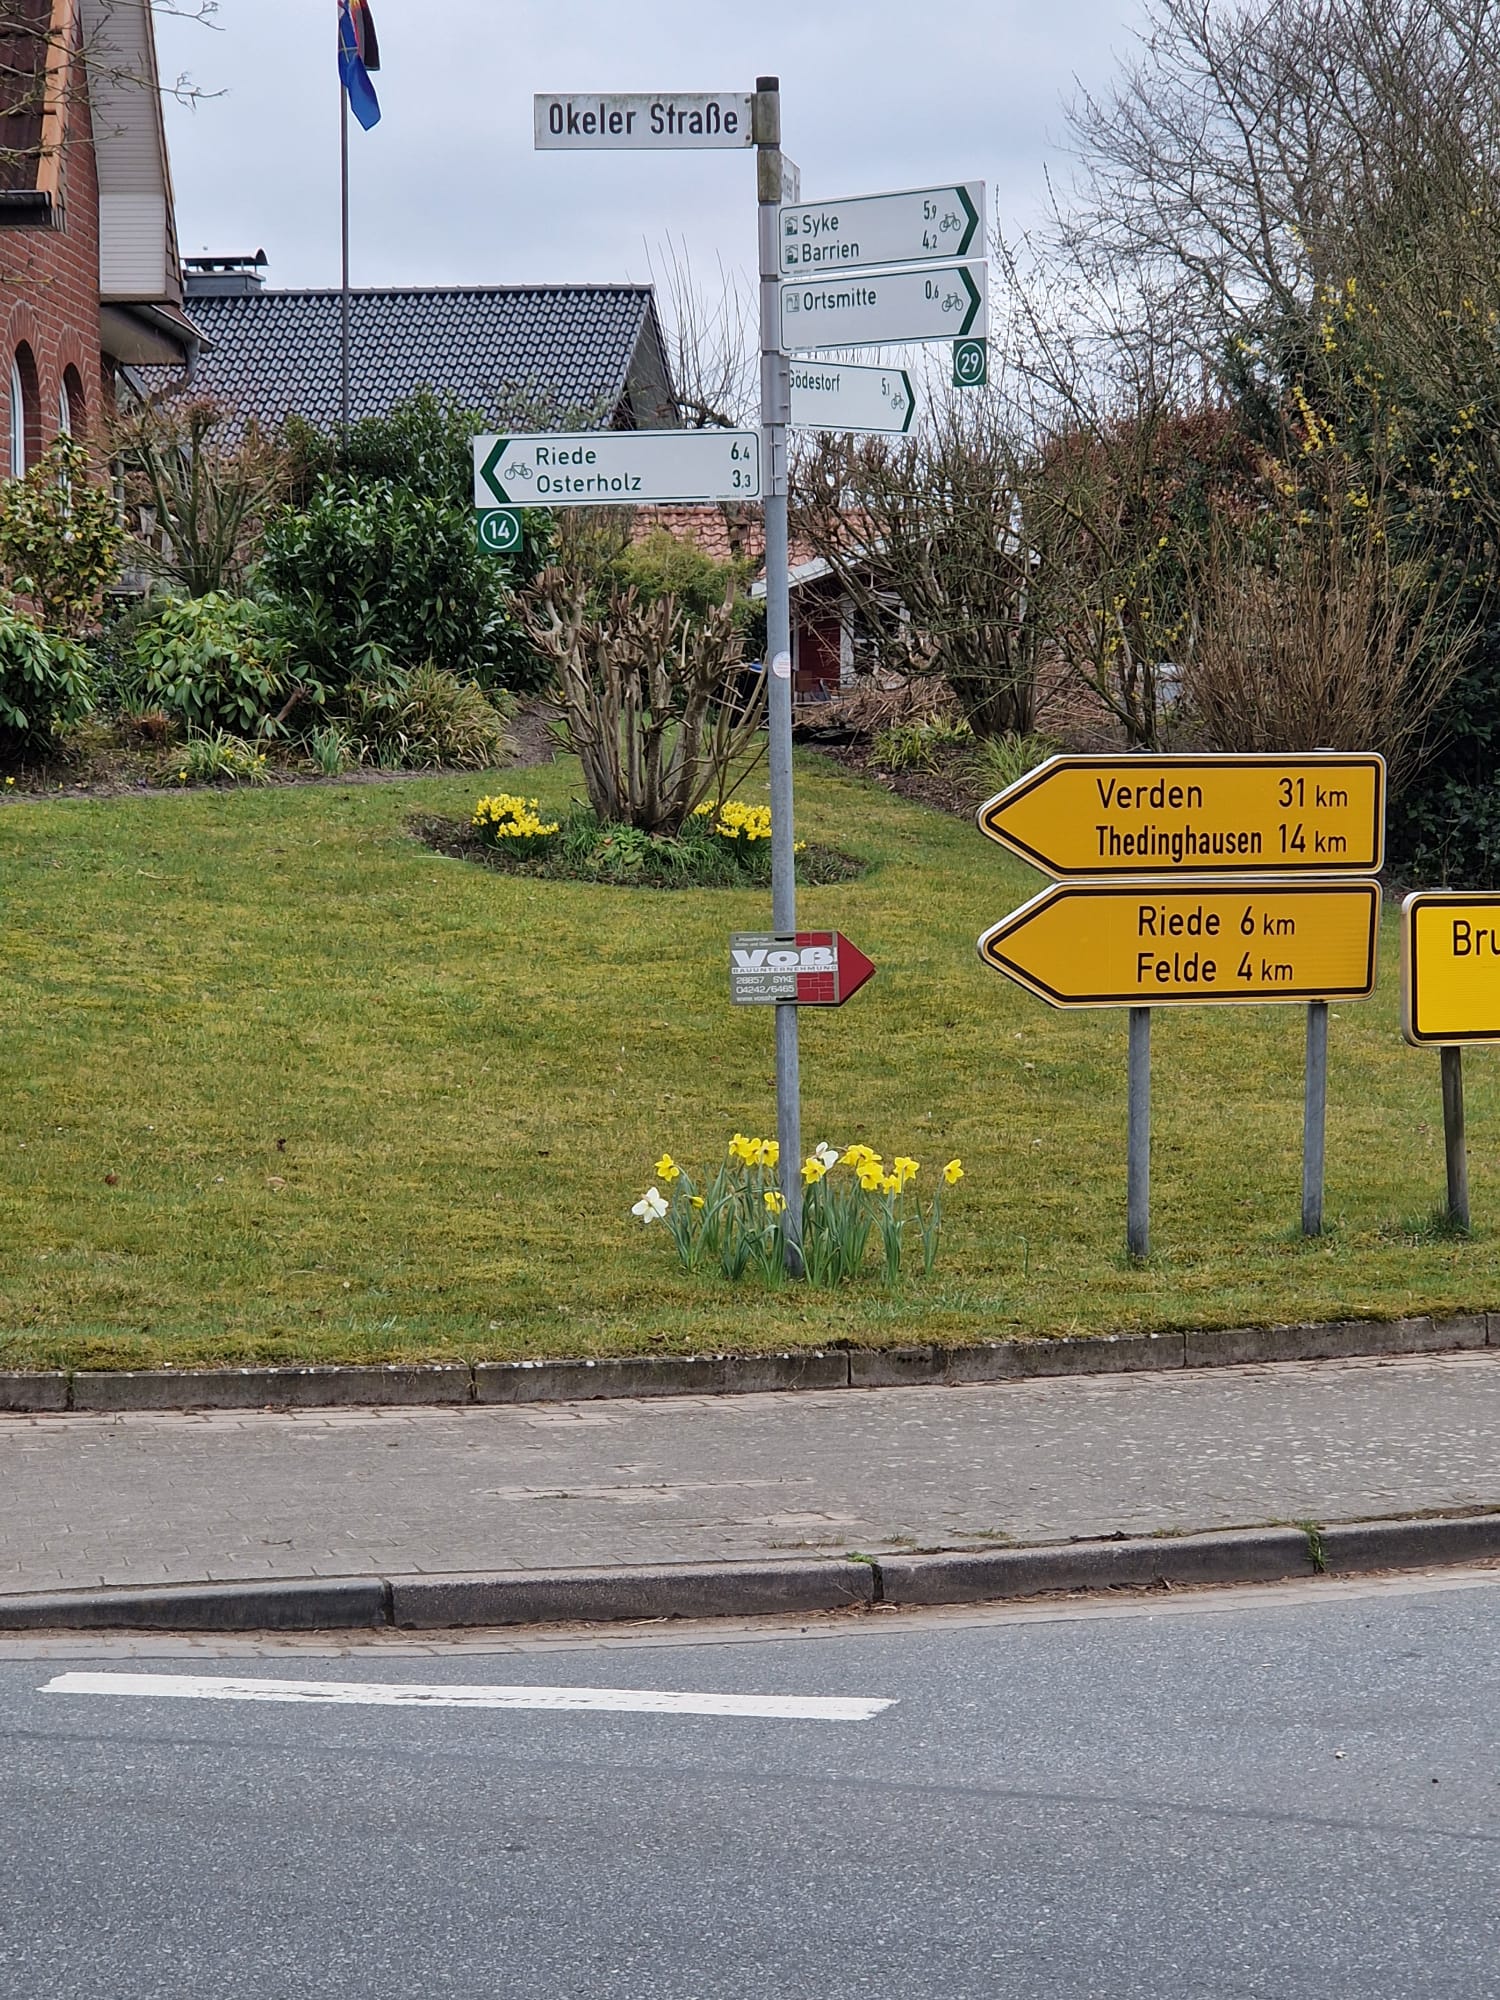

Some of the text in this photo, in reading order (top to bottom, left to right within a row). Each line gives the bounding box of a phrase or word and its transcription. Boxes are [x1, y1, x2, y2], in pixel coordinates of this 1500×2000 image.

[549, 102, 738, 134] Okeler Straße
[802, 212, 839, 238] Syke
[802, 240, 860, 263] Barrien
[803, 287, 877, 312] Ortsmitte
[961, 351, 980, 374] 29
[536, 446, 597, 466] Riede
[536, 473, 642, 494] Osterholz
[489, 519, 510, 538] 14
[1096, 777, 1348, 809] Verden 31 km
[1096, 823, 1347, 863] Thedinghausen 14 km
[1137, 905, 1295, 936] Riede 6 km
[1137, 951, 1293, 982] Felde 4 km
[736, 975, 795, 985] 28857 SYKE
